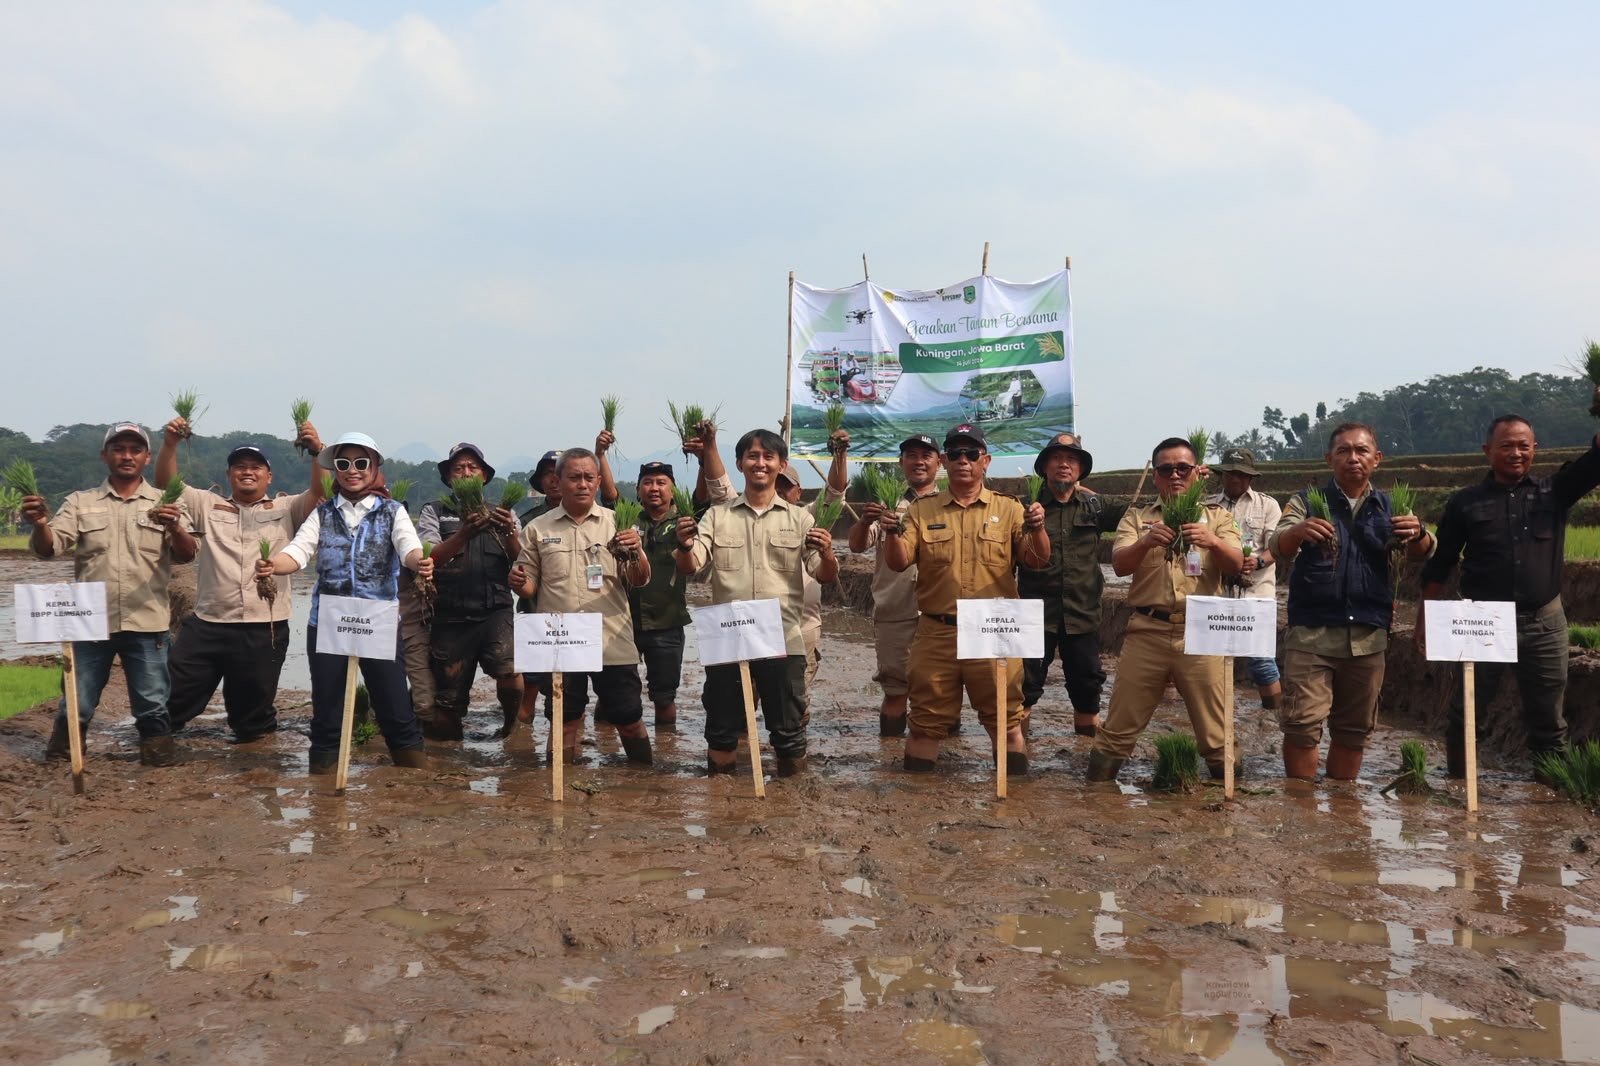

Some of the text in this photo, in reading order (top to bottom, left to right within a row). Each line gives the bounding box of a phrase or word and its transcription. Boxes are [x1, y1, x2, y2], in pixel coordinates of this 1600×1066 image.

[906, 311, 1059, 338] Gerakan Tanam Bersama
[916, 348, 966, 359] Kuningan,
[995, 342, 1026, 352] Barat
[340, 615, 371, 625] KEPALA
[720, 618, 756, 628] MUSTANI
[1207, 613, 1256, 623] KODIM 0615
[1452, 618, 1495, 627] KATIMKER
[337, 625, 374, 636] BPPSDMP
[1209, 624, 1254, 632] KUNINGAN
[1451, 629, 1495, 637] KUNINGAN
